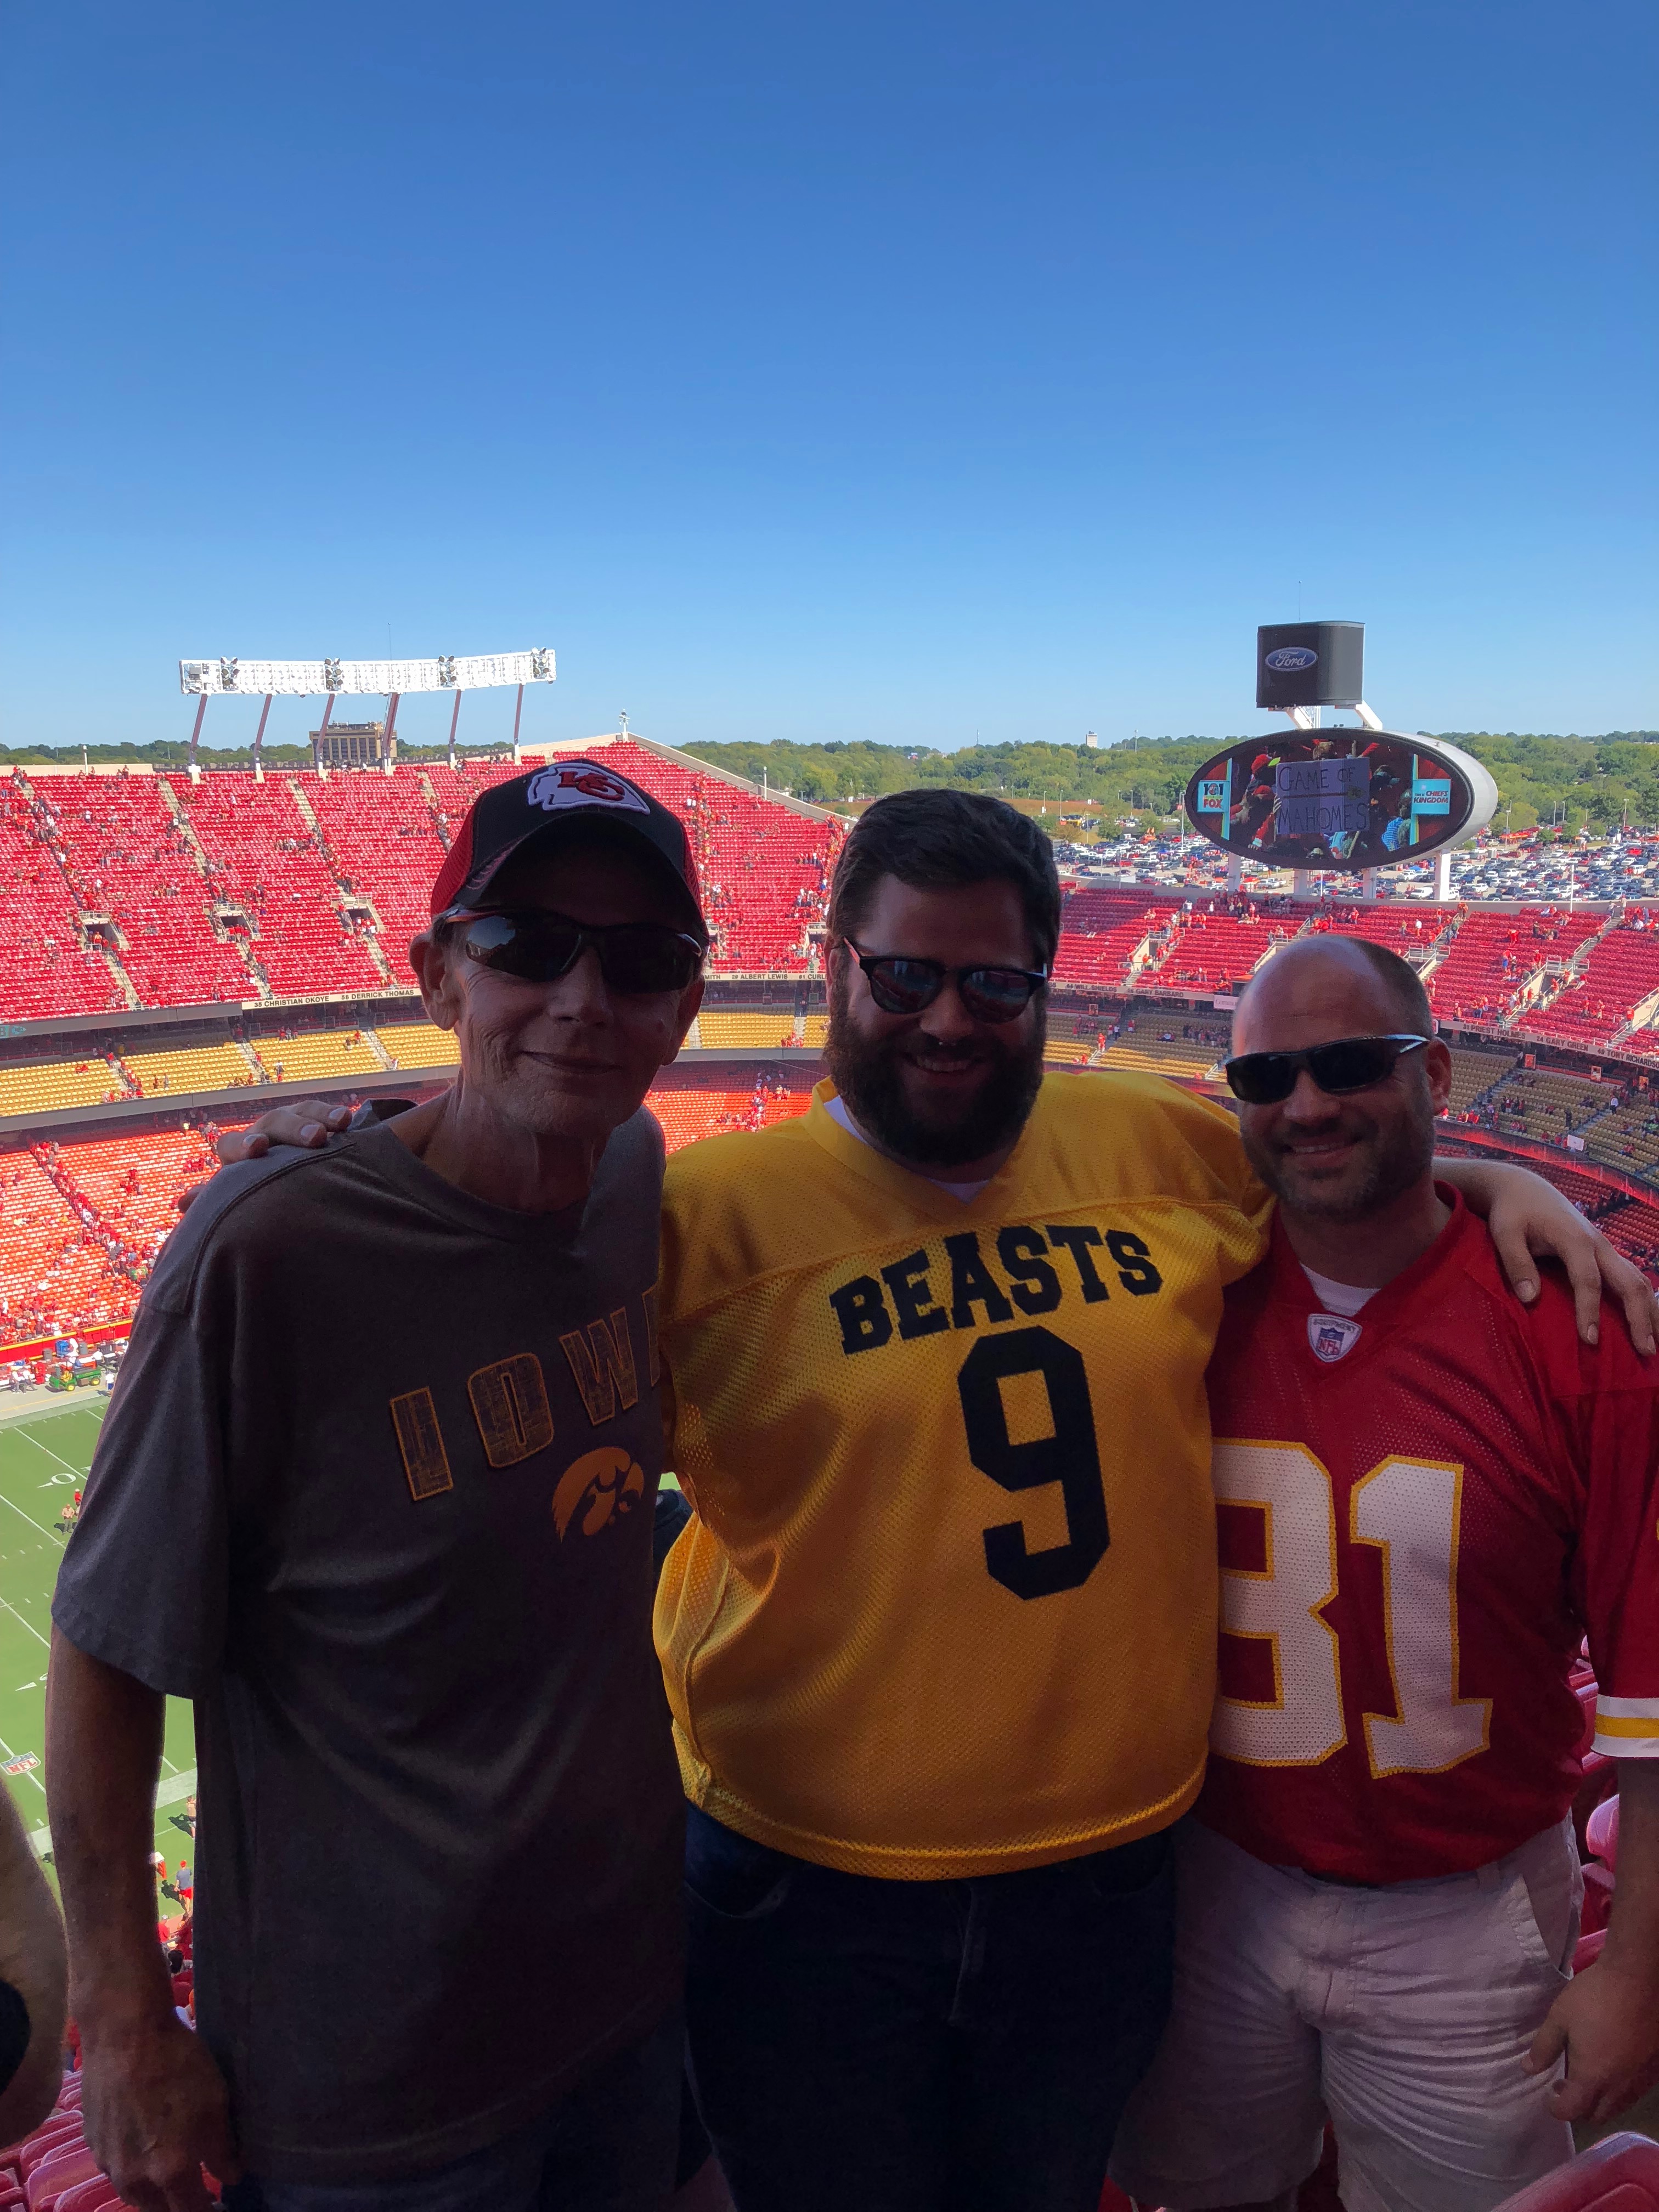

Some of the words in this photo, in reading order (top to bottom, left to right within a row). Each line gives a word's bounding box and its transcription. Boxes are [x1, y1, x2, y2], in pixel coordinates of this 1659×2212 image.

[1276, 651, 1307, 667] Ford
[557, 771, 625, 801] KC
[1279, 766, 1329, 791] GAME
[1338, 767, 1356, 782] OF
[1203, 799, 1223, 808] FOX
[1278, 803, 1369, 833] MAHOMES
[264, 998, 303, 1007] CHRISTIAN
[351, 991, 383, 1000] DERRICK
[1471, 1025, 1496, 1035] PRIEST
[1497, 1028, 1526, 1039] HOLMES
[1546, 1037, 1565, 1047] GARY
[1567, 1041, 1589, 1052] GREEN
[1607, 1049, 1625, 1059] TONY
[829, 1226, 1164, 1356] BEASTS
[1318, 1338, 1340, 1354] NFL
[957, 1325, 1111, 1600] 9
[7, 1759, 37, 1773] NFL
